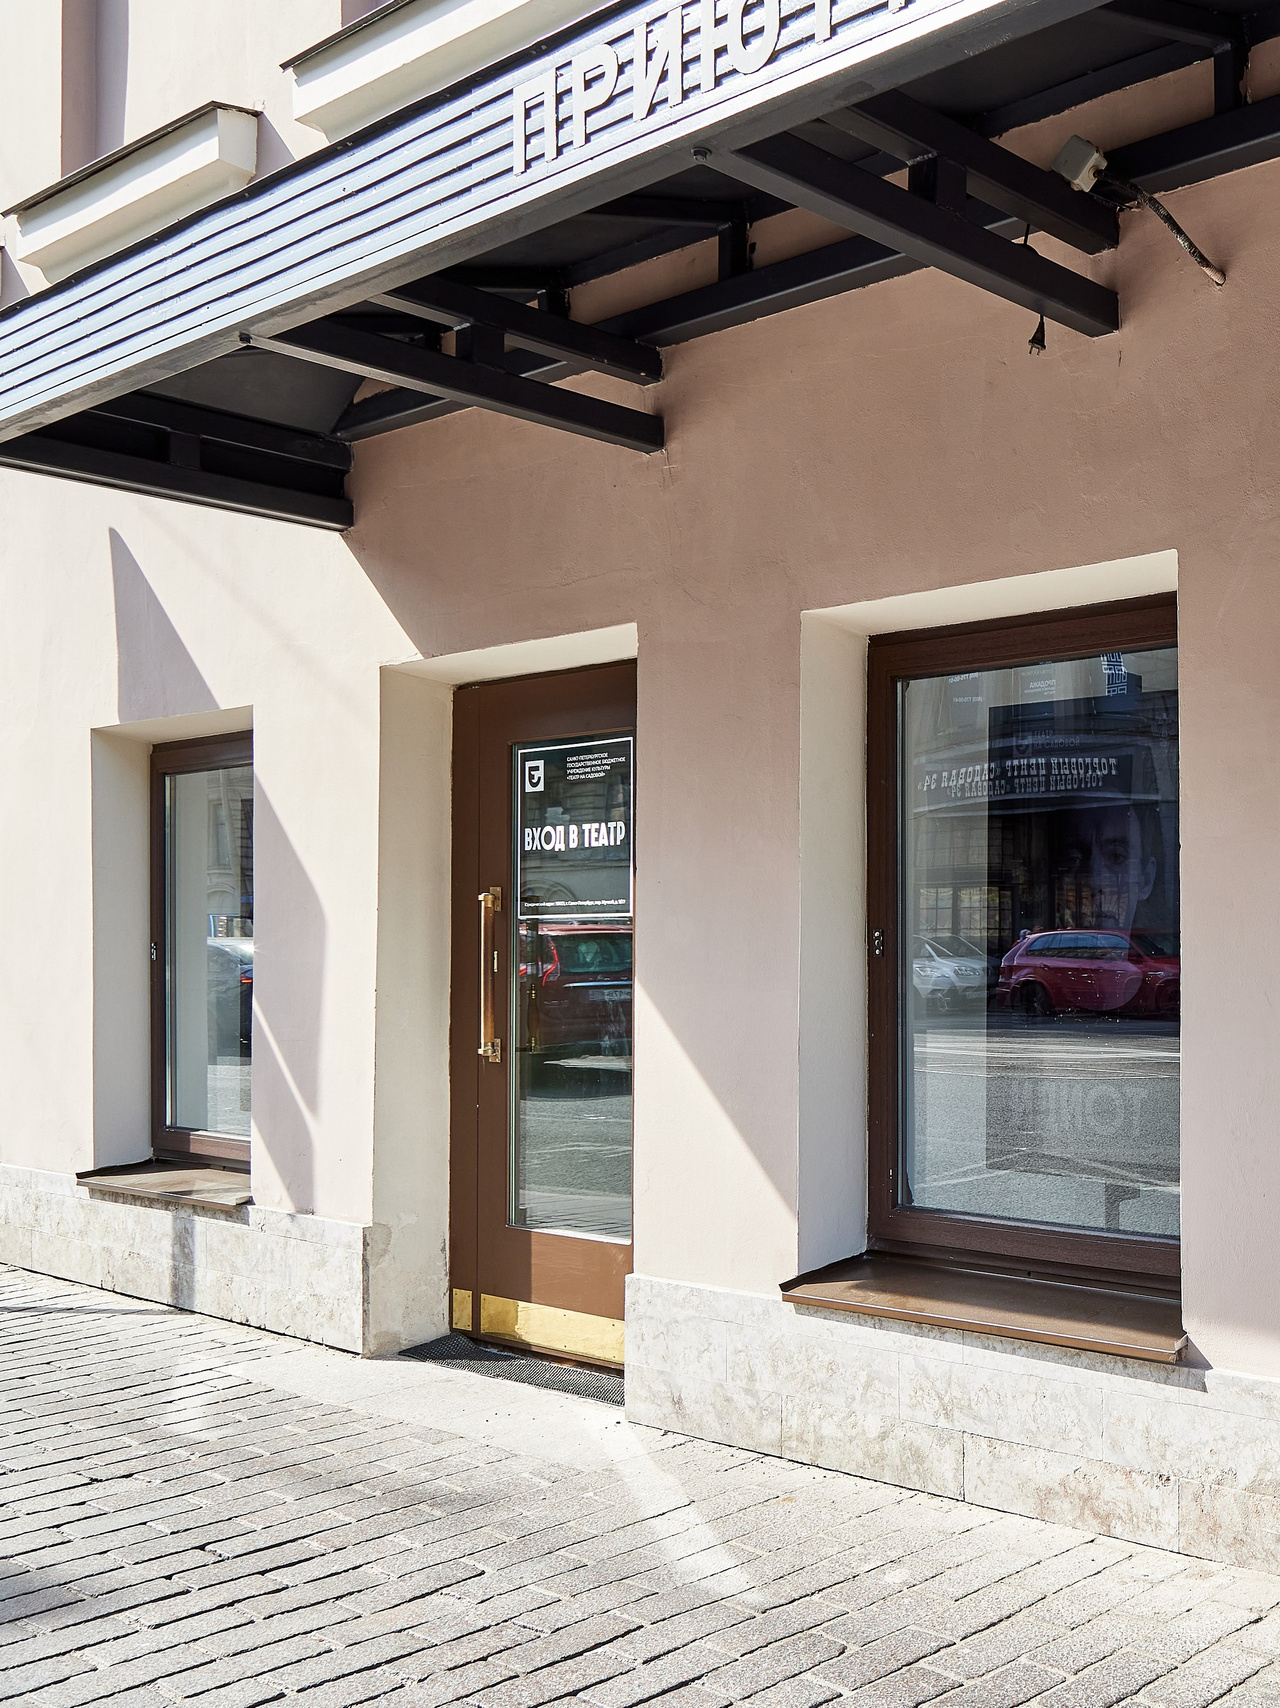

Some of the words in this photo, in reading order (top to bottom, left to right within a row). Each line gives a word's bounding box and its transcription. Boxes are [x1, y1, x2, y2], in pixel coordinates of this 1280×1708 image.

[524, 825, 566, 852] ВХОД
[569, 824, 578, 849] В
[582, 821, 626, 848] ТЕАТР
